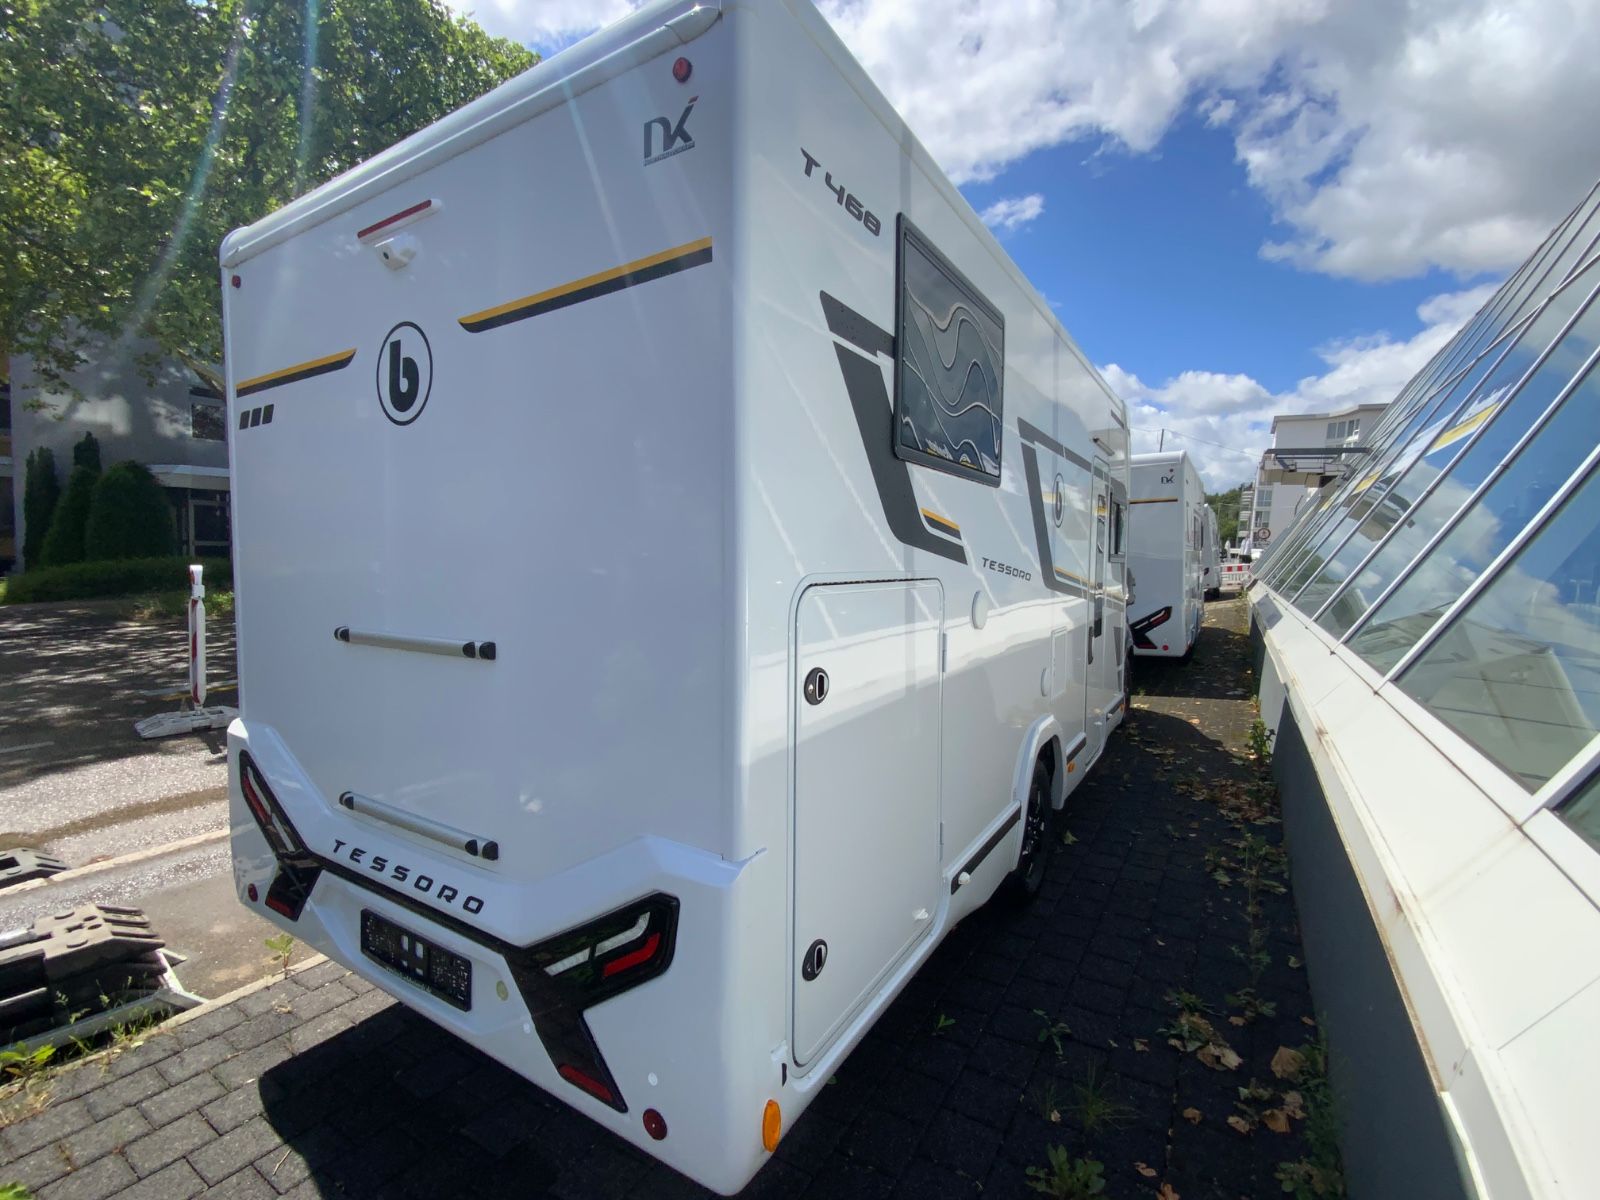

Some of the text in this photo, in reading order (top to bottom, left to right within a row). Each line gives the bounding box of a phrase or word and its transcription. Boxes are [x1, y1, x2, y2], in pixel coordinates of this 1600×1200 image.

[801, 147, 881, 236] T 468
[982, 557, 1032, 582] TESSORO
[332, 839, 484, 914] TESSORO
